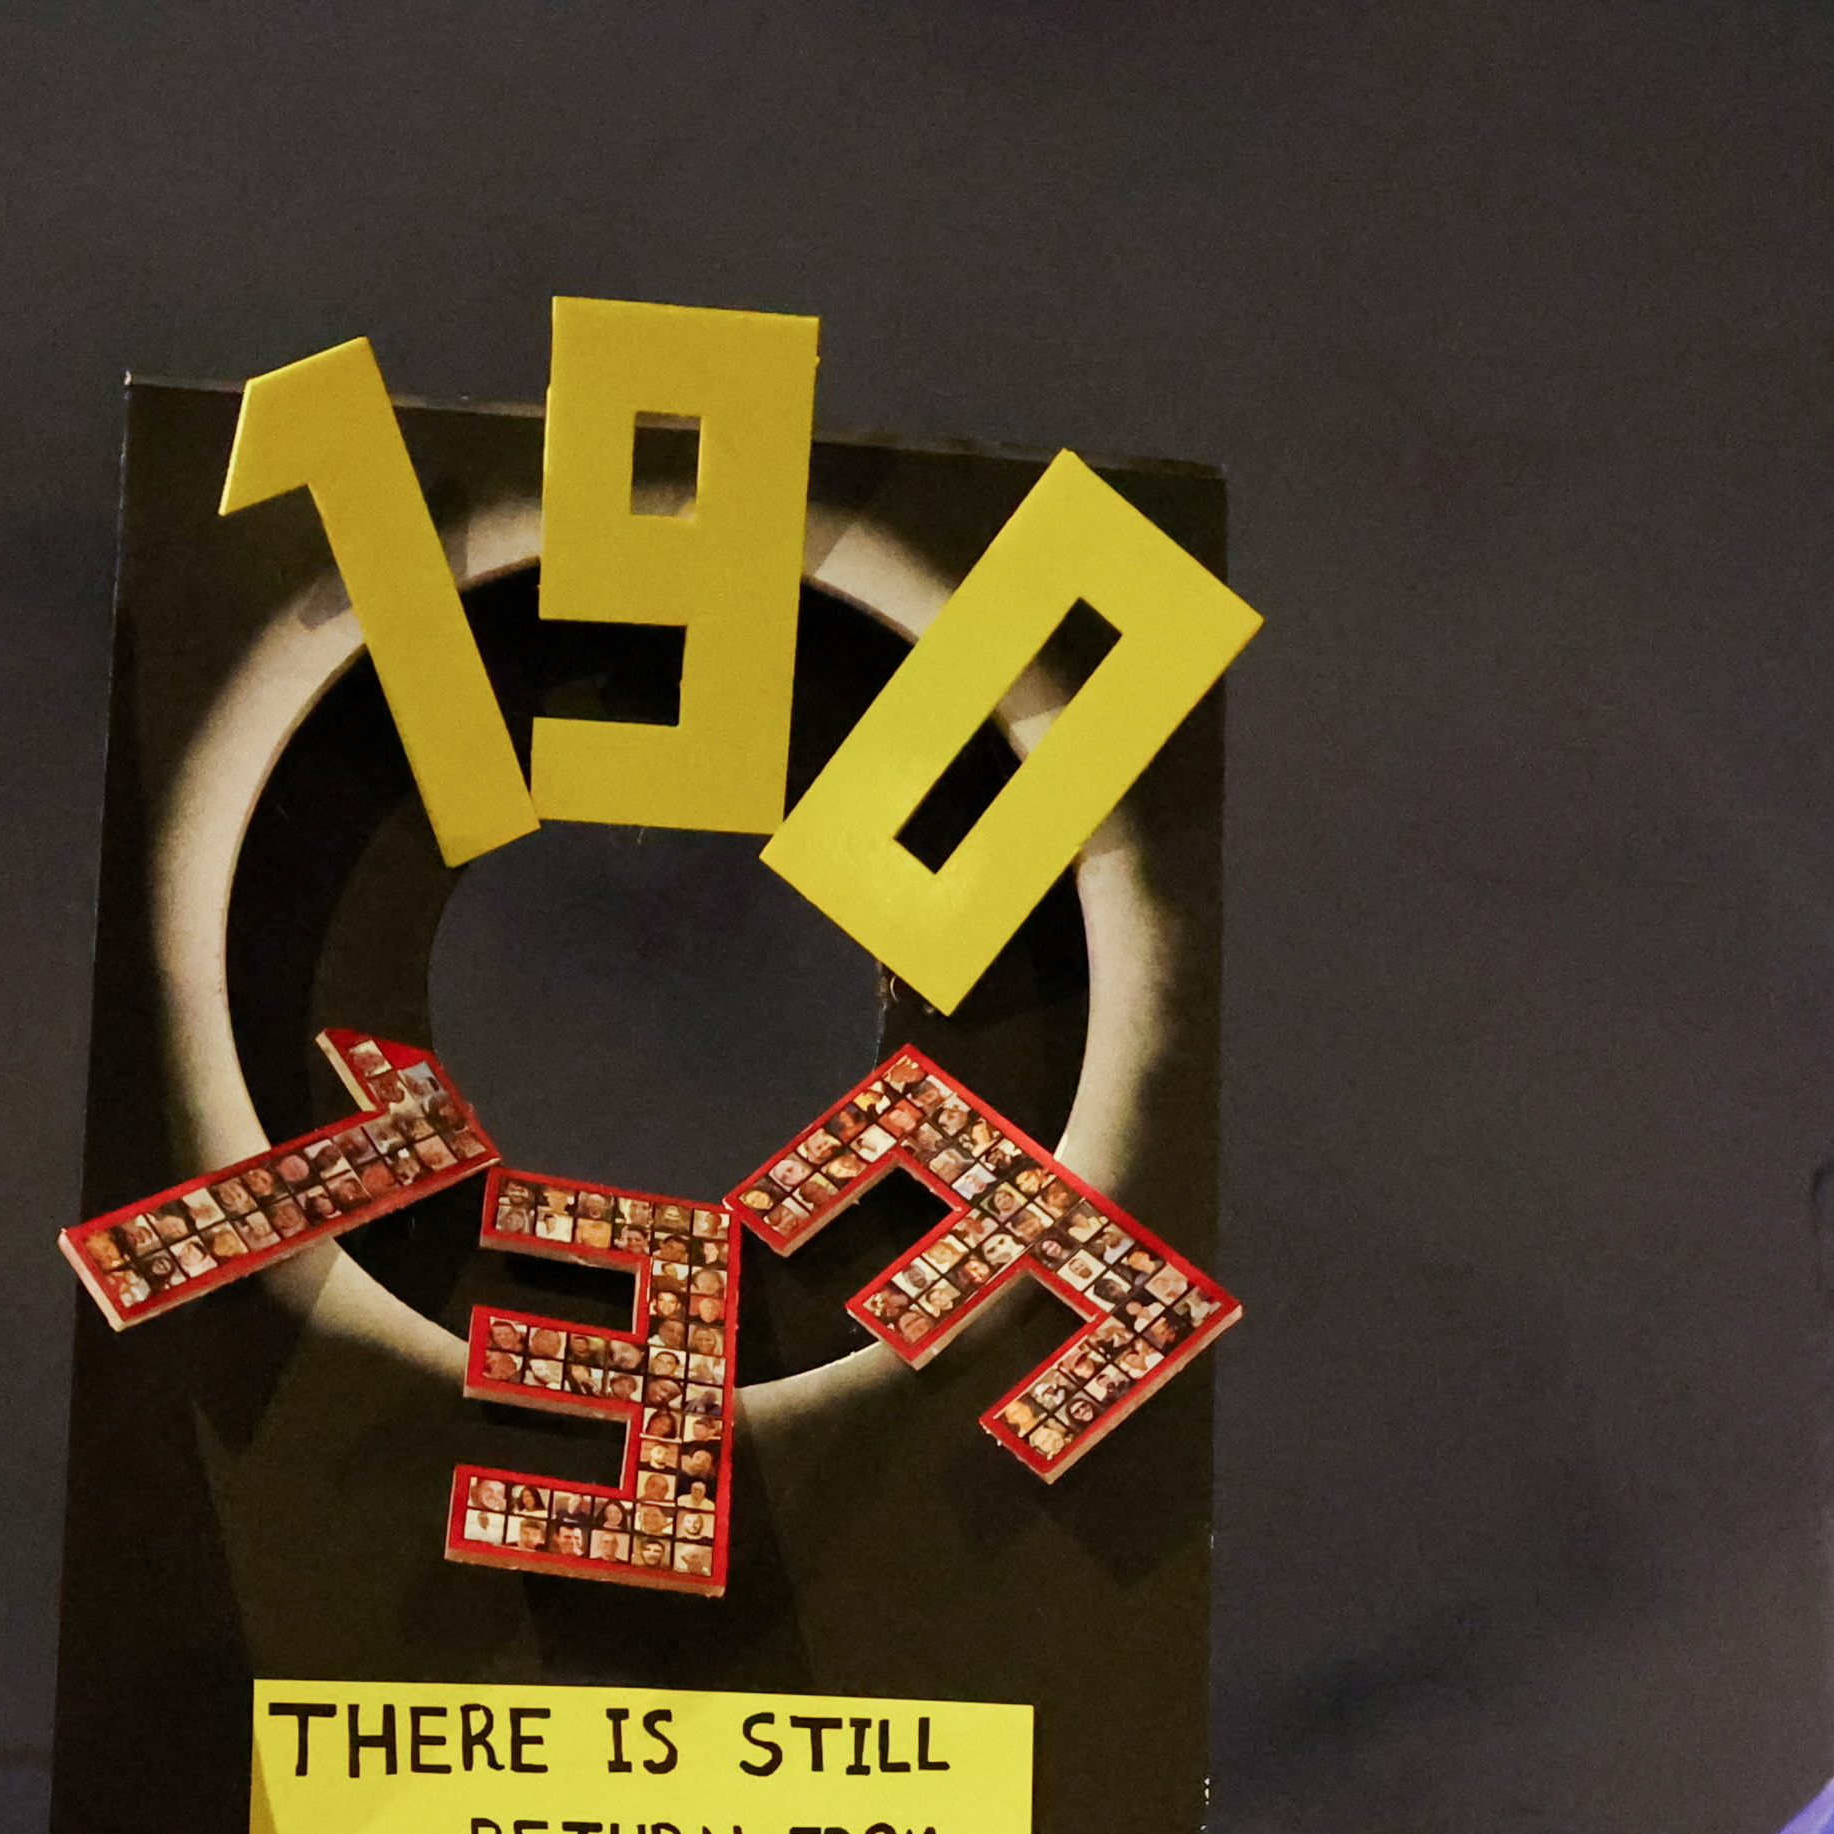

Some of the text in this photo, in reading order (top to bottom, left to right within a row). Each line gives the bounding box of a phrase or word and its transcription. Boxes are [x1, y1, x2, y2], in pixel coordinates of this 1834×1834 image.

[220, 296, 1264, 1015] 190
[58, 1028, 1244, 1597] 133
[269, 1703, 951, 1778] THERE IS STILL
